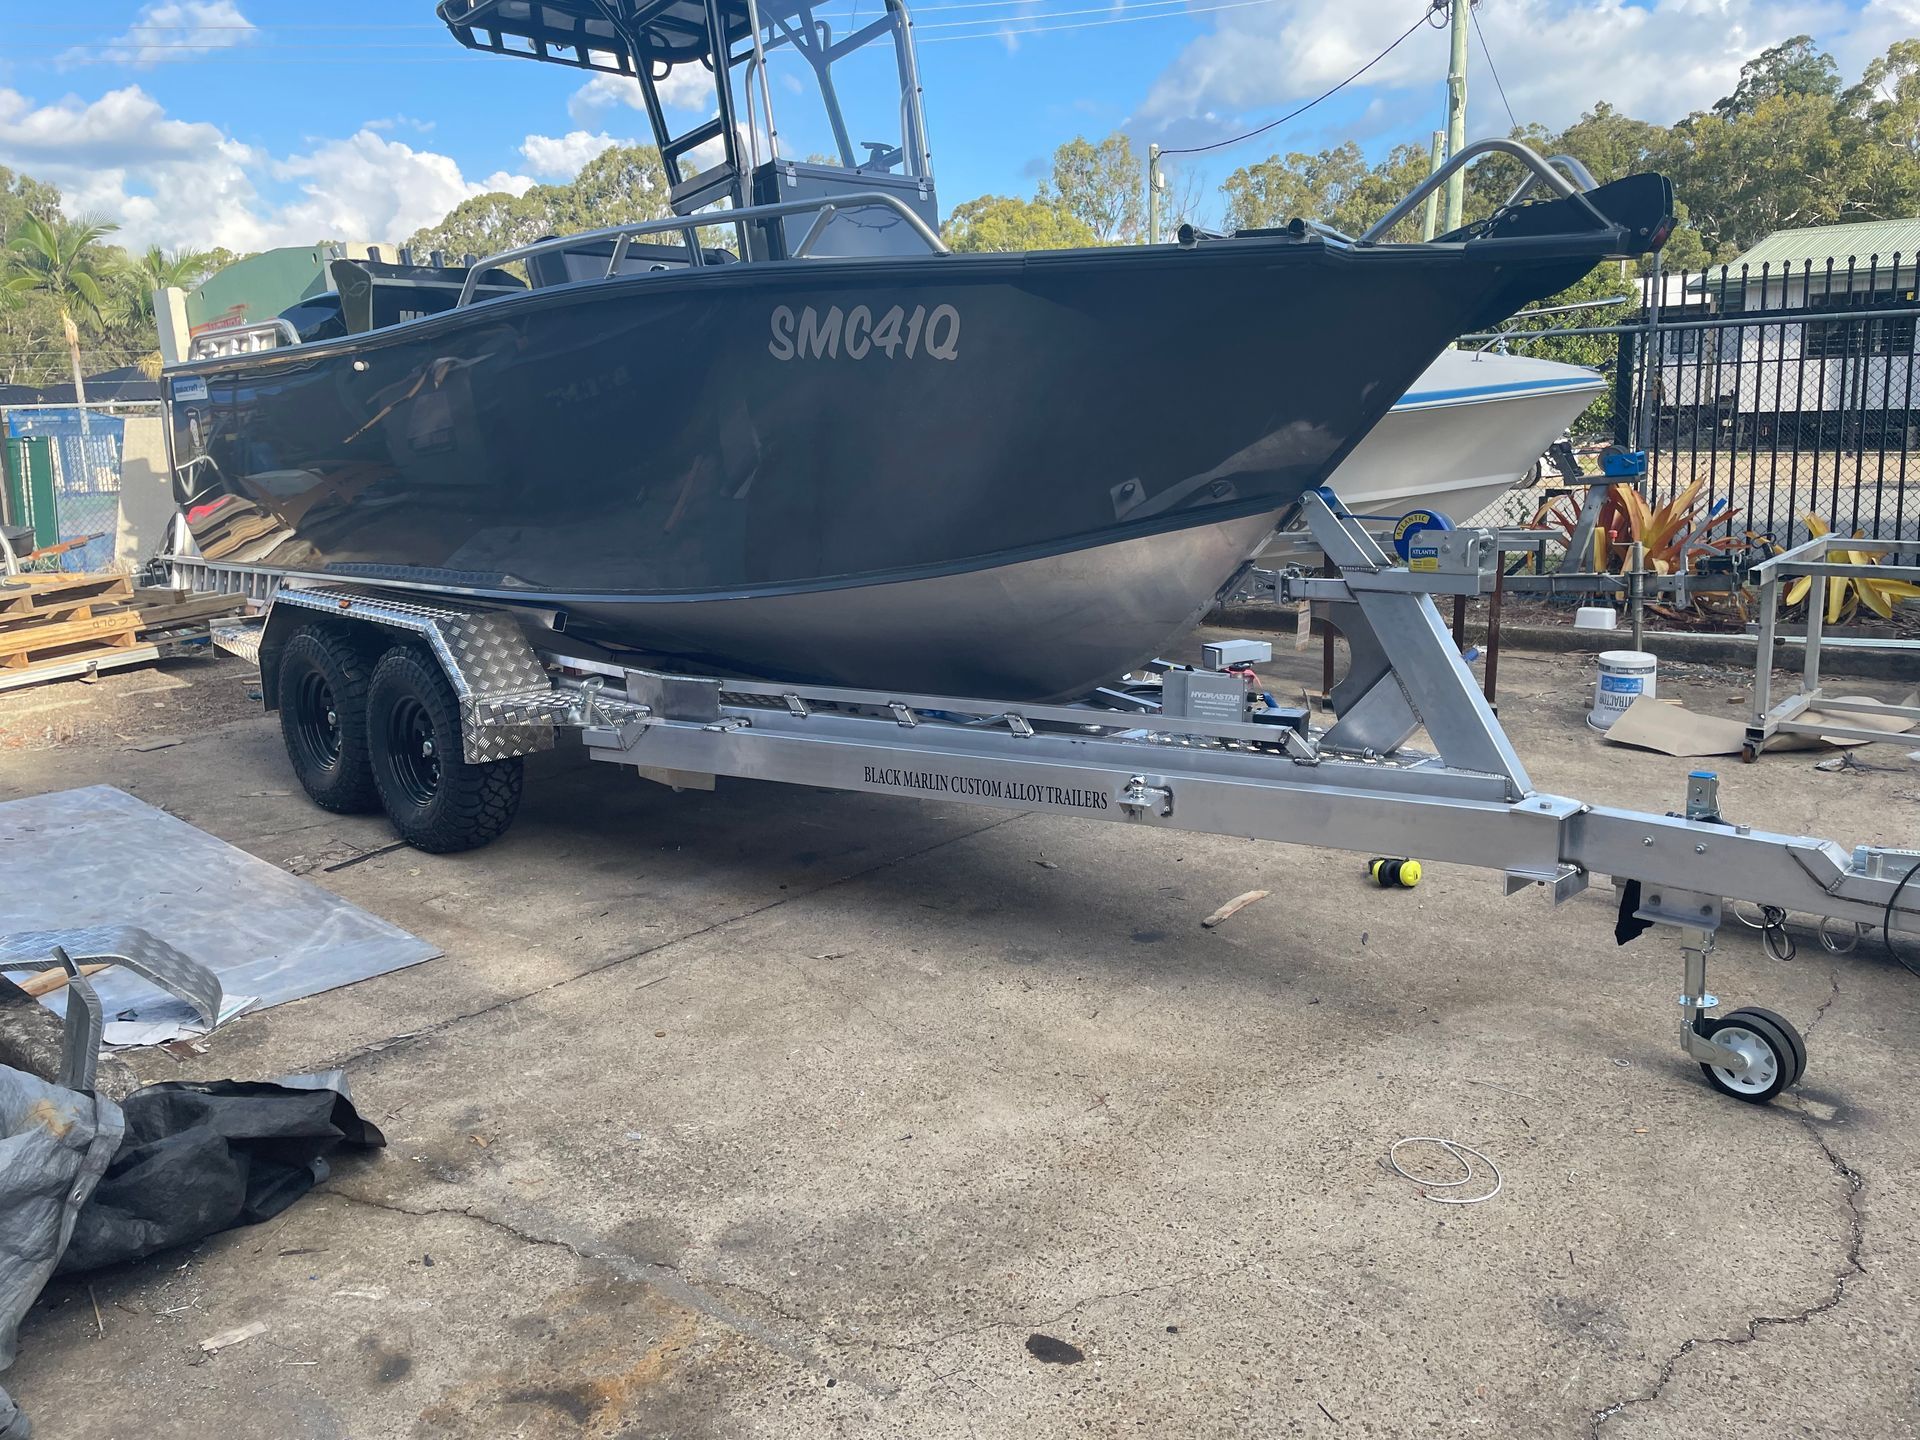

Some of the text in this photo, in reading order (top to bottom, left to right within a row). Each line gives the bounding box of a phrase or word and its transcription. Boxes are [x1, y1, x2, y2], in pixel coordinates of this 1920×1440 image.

[769, 304, 960, 360] SMC41Q
[1396, 514, 1428, 537] ATLANTIC
[1190, 690, 1241, 702] HYDRASTAR
[864, 766, 1108, 810] BLACK MARLIN CUSTOM ALLOY TRAILERS
